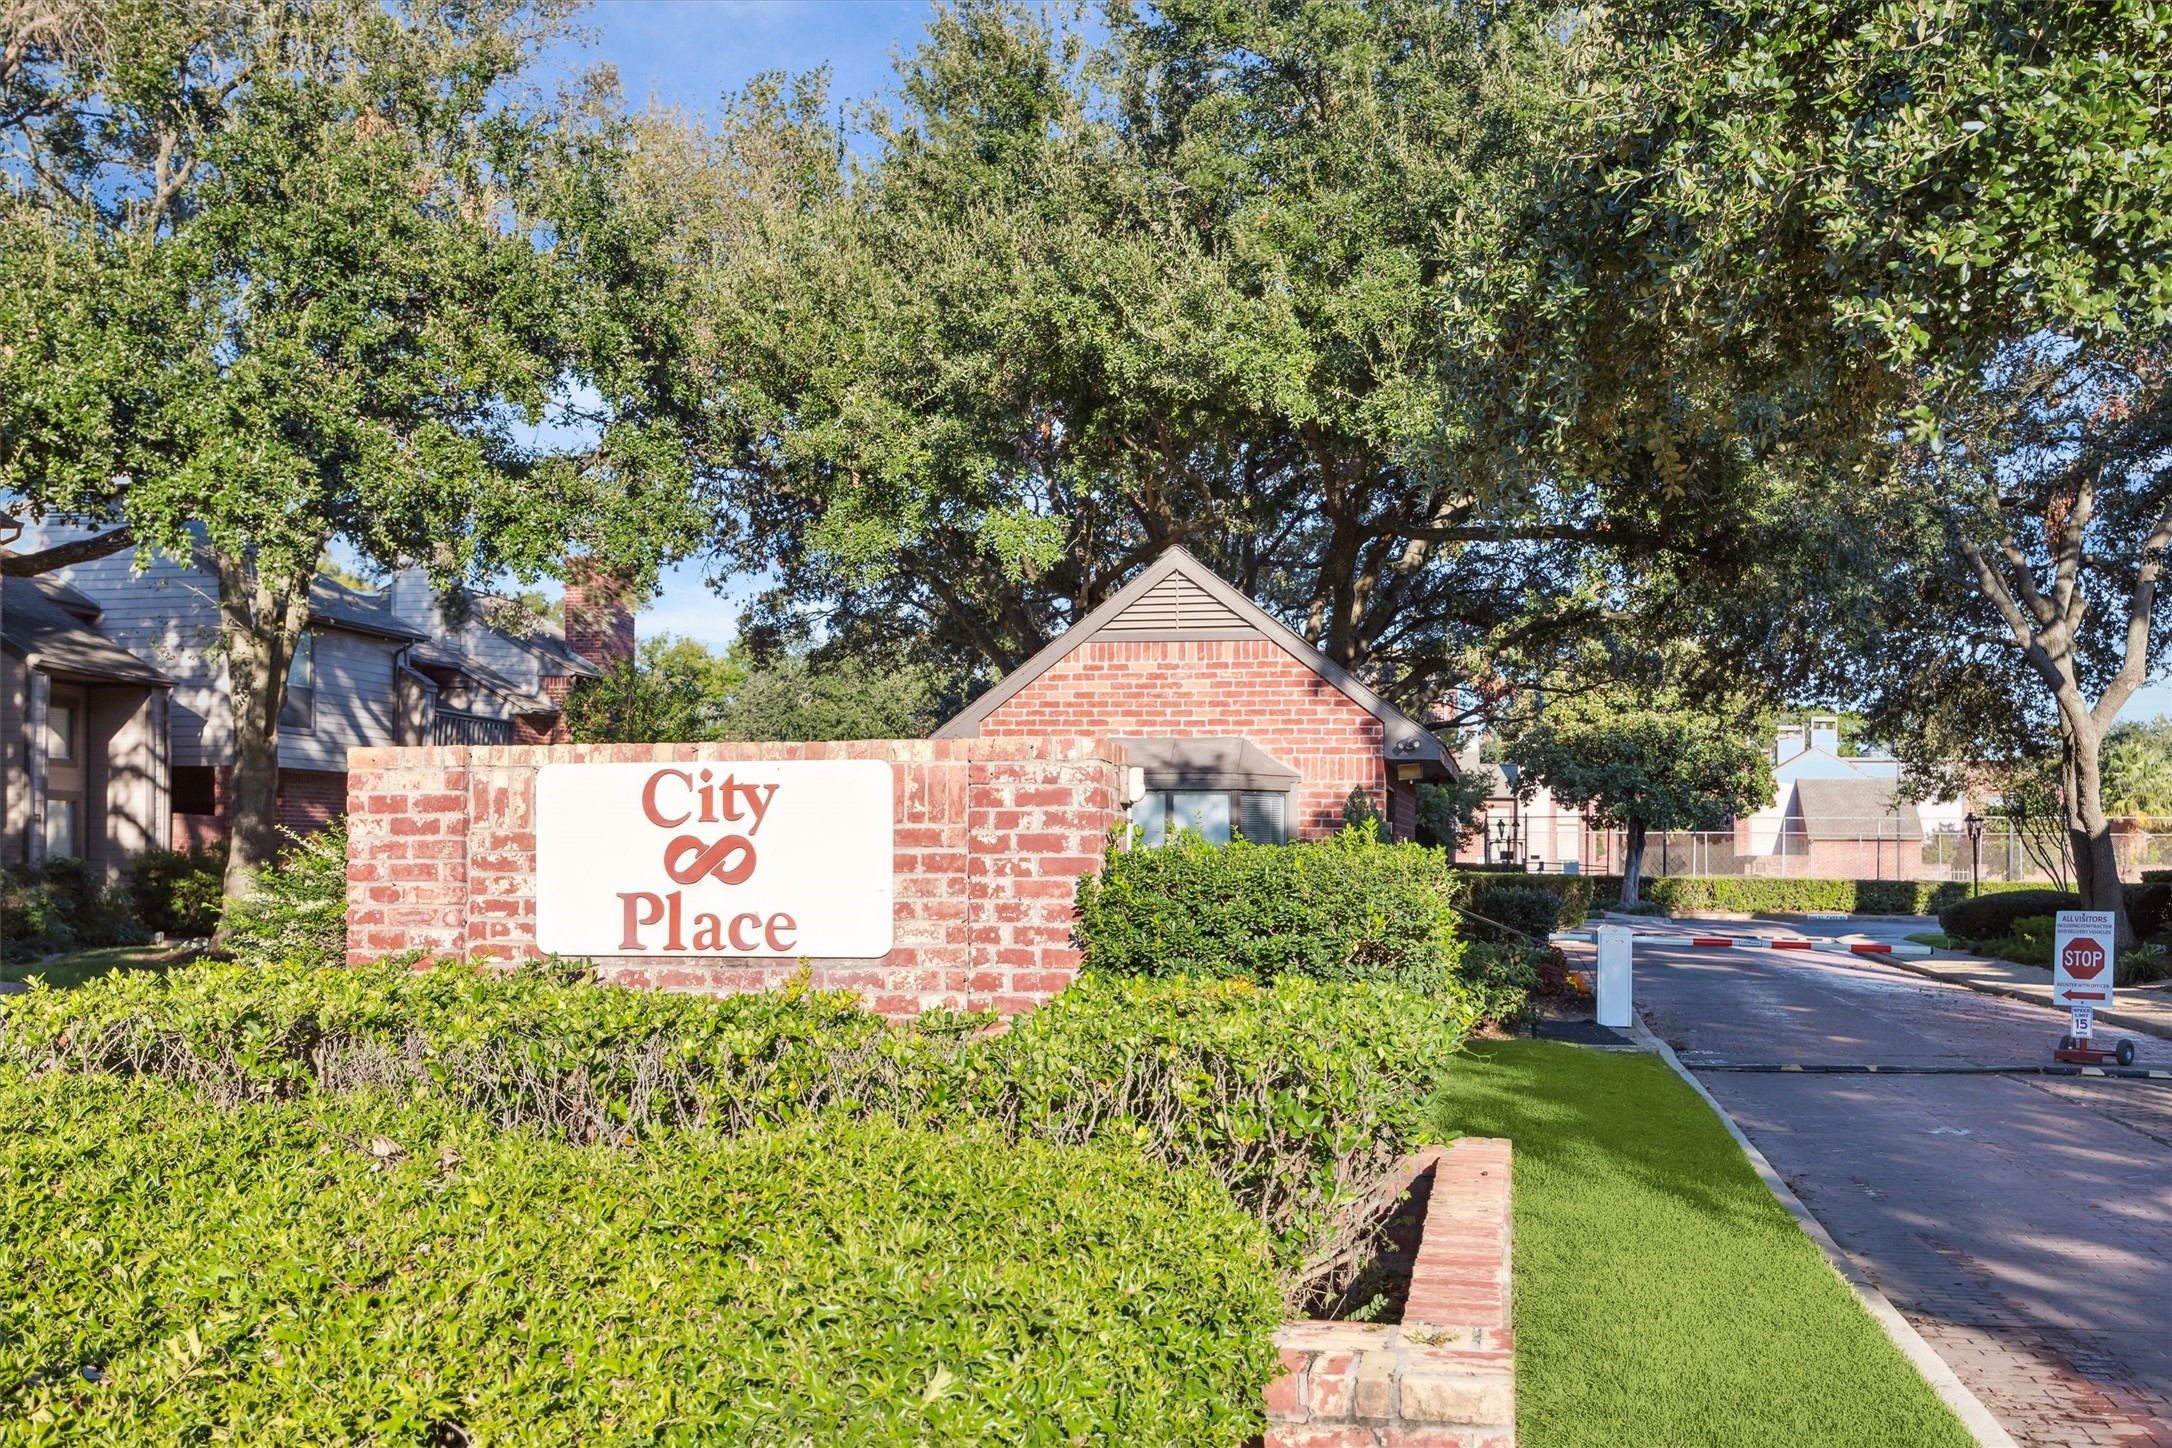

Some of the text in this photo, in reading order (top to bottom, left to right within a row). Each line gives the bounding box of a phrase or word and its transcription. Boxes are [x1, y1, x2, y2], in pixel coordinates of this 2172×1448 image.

[641, 768, 780, 836] City
[616, 890, 797, 951] Place
[2064, 950, 2103, 967] STOP
[2076, 1019, 2087, 1029] 15
